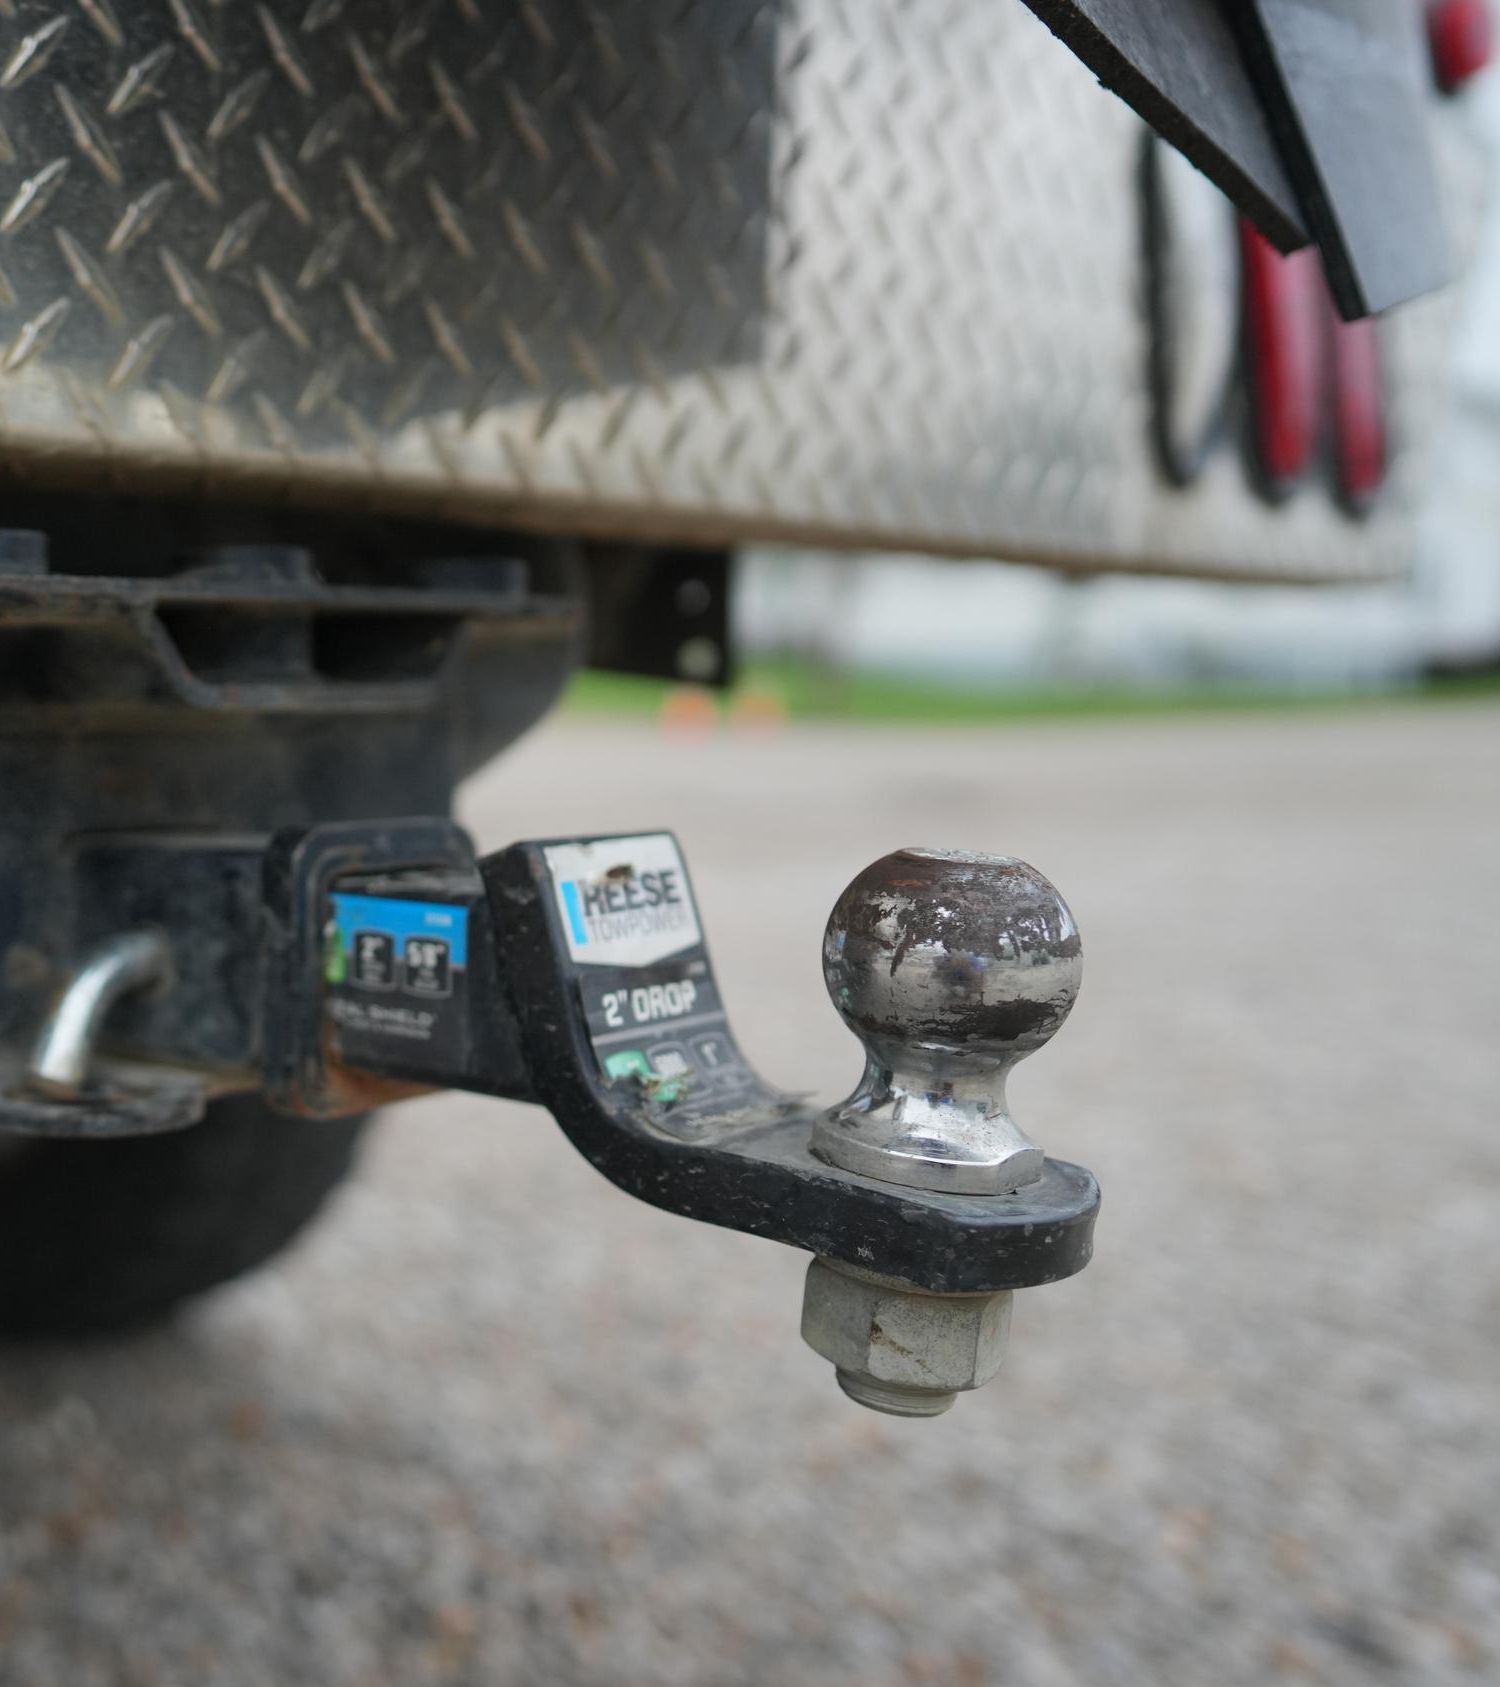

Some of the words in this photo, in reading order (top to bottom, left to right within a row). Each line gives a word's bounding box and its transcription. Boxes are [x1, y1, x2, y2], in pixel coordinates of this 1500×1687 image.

[579, 869, 682, 918] REESE
[586, 908, 690, 945] TOWPOWER
[601, 989, 629, 1028] 2"
[631, 979, 698, 1022] DROP
